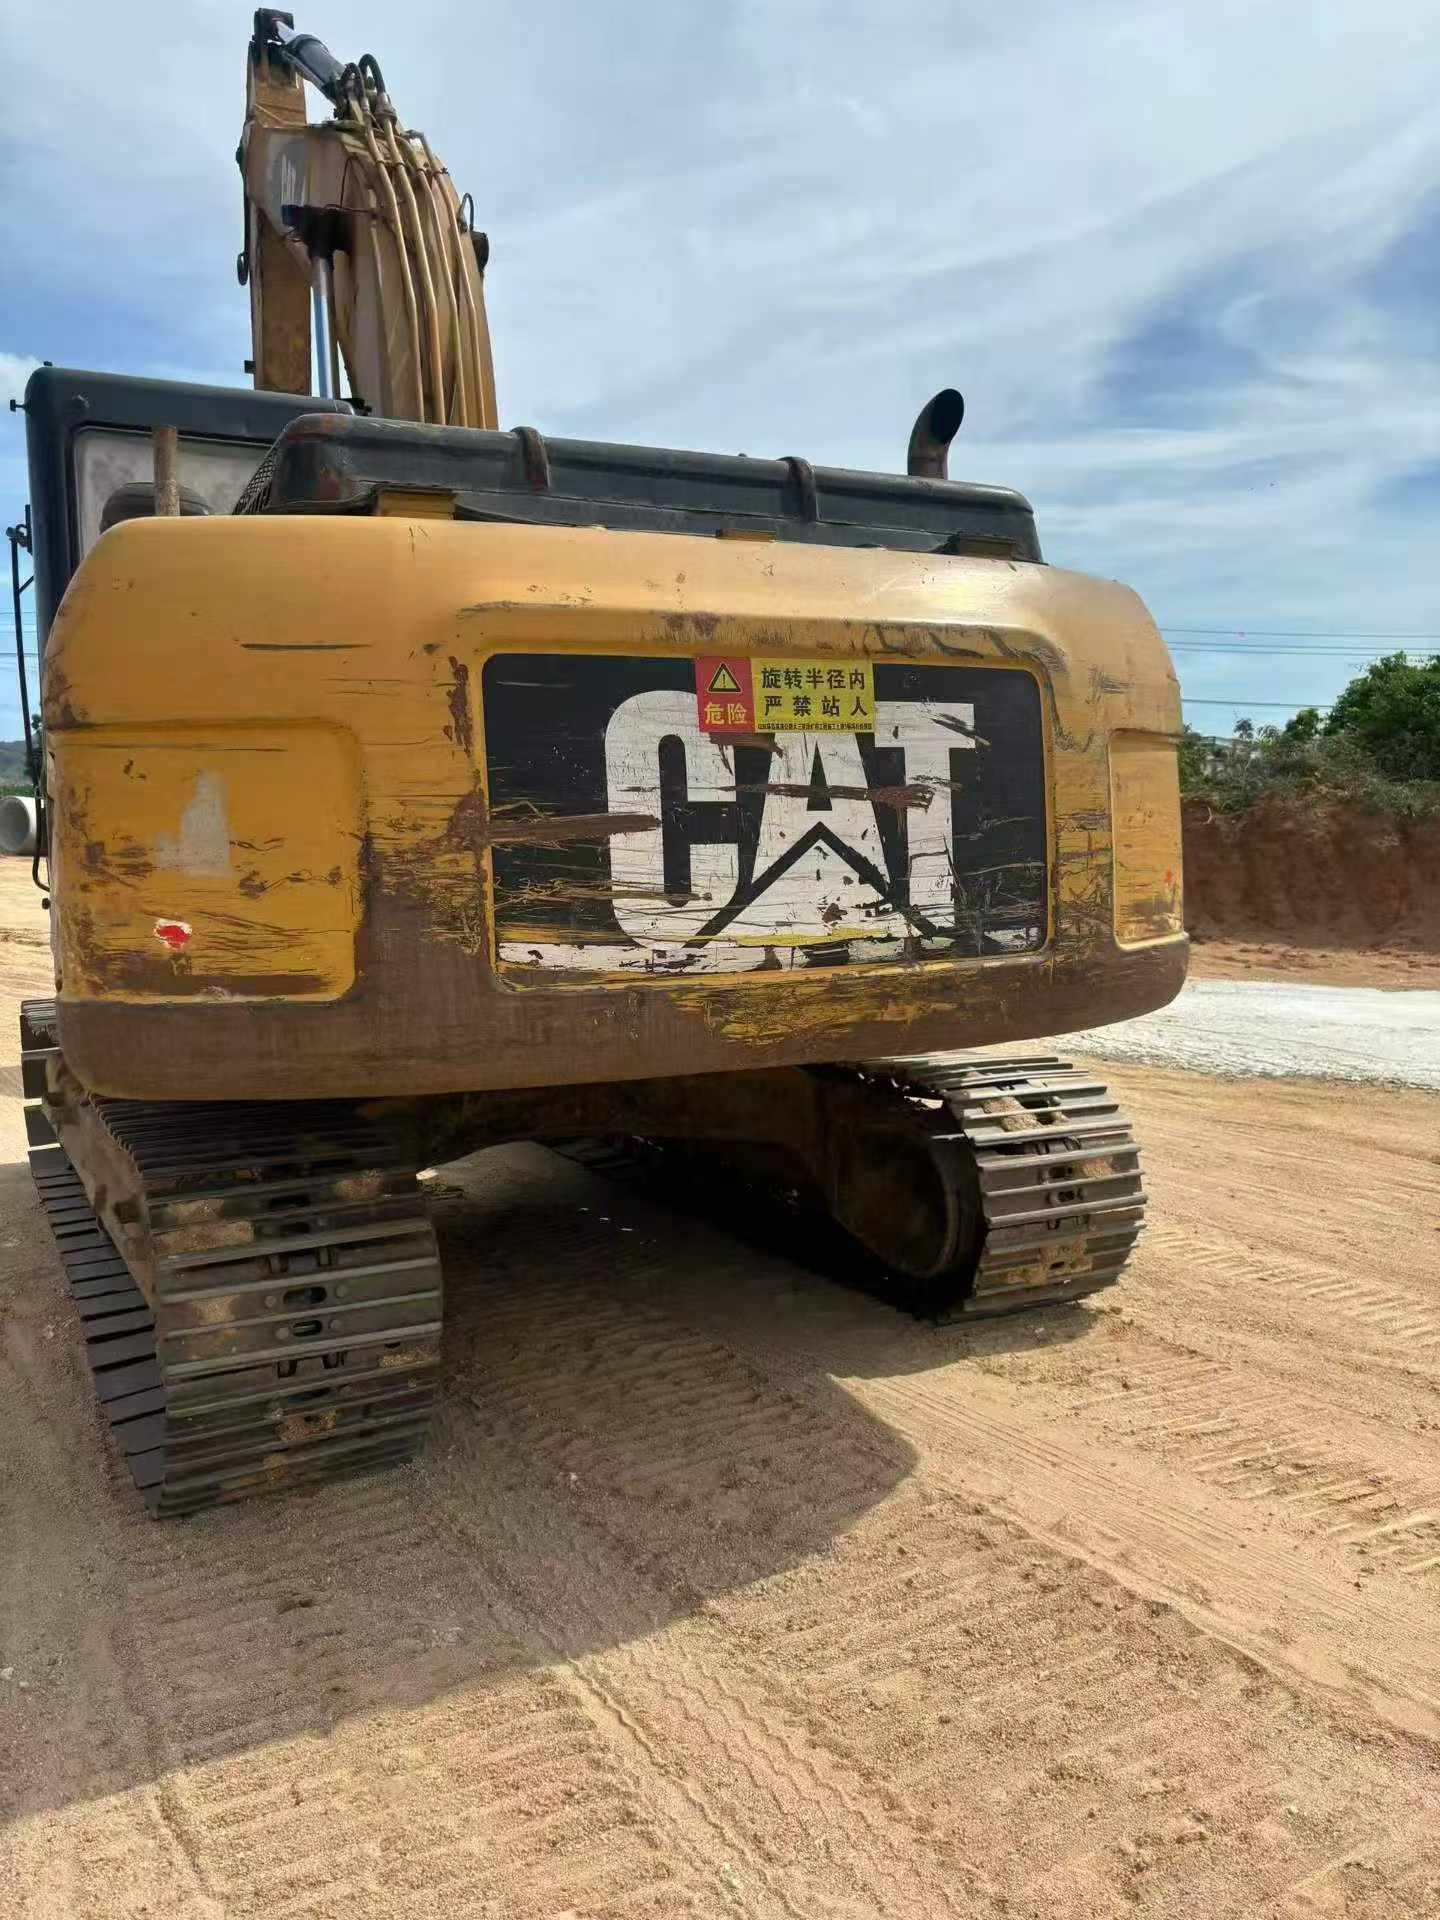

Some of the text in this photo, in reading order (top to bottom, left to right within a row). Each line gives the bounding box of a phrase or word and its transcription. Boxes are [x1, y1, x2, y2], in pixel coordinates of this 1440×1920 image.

[761, 668, 865, 690] 旋转半径内
[705, 702, 748, 725] 危险
[764, 695, 867, 717] 严禁站人
[605, 690, 975, 948] CAT
